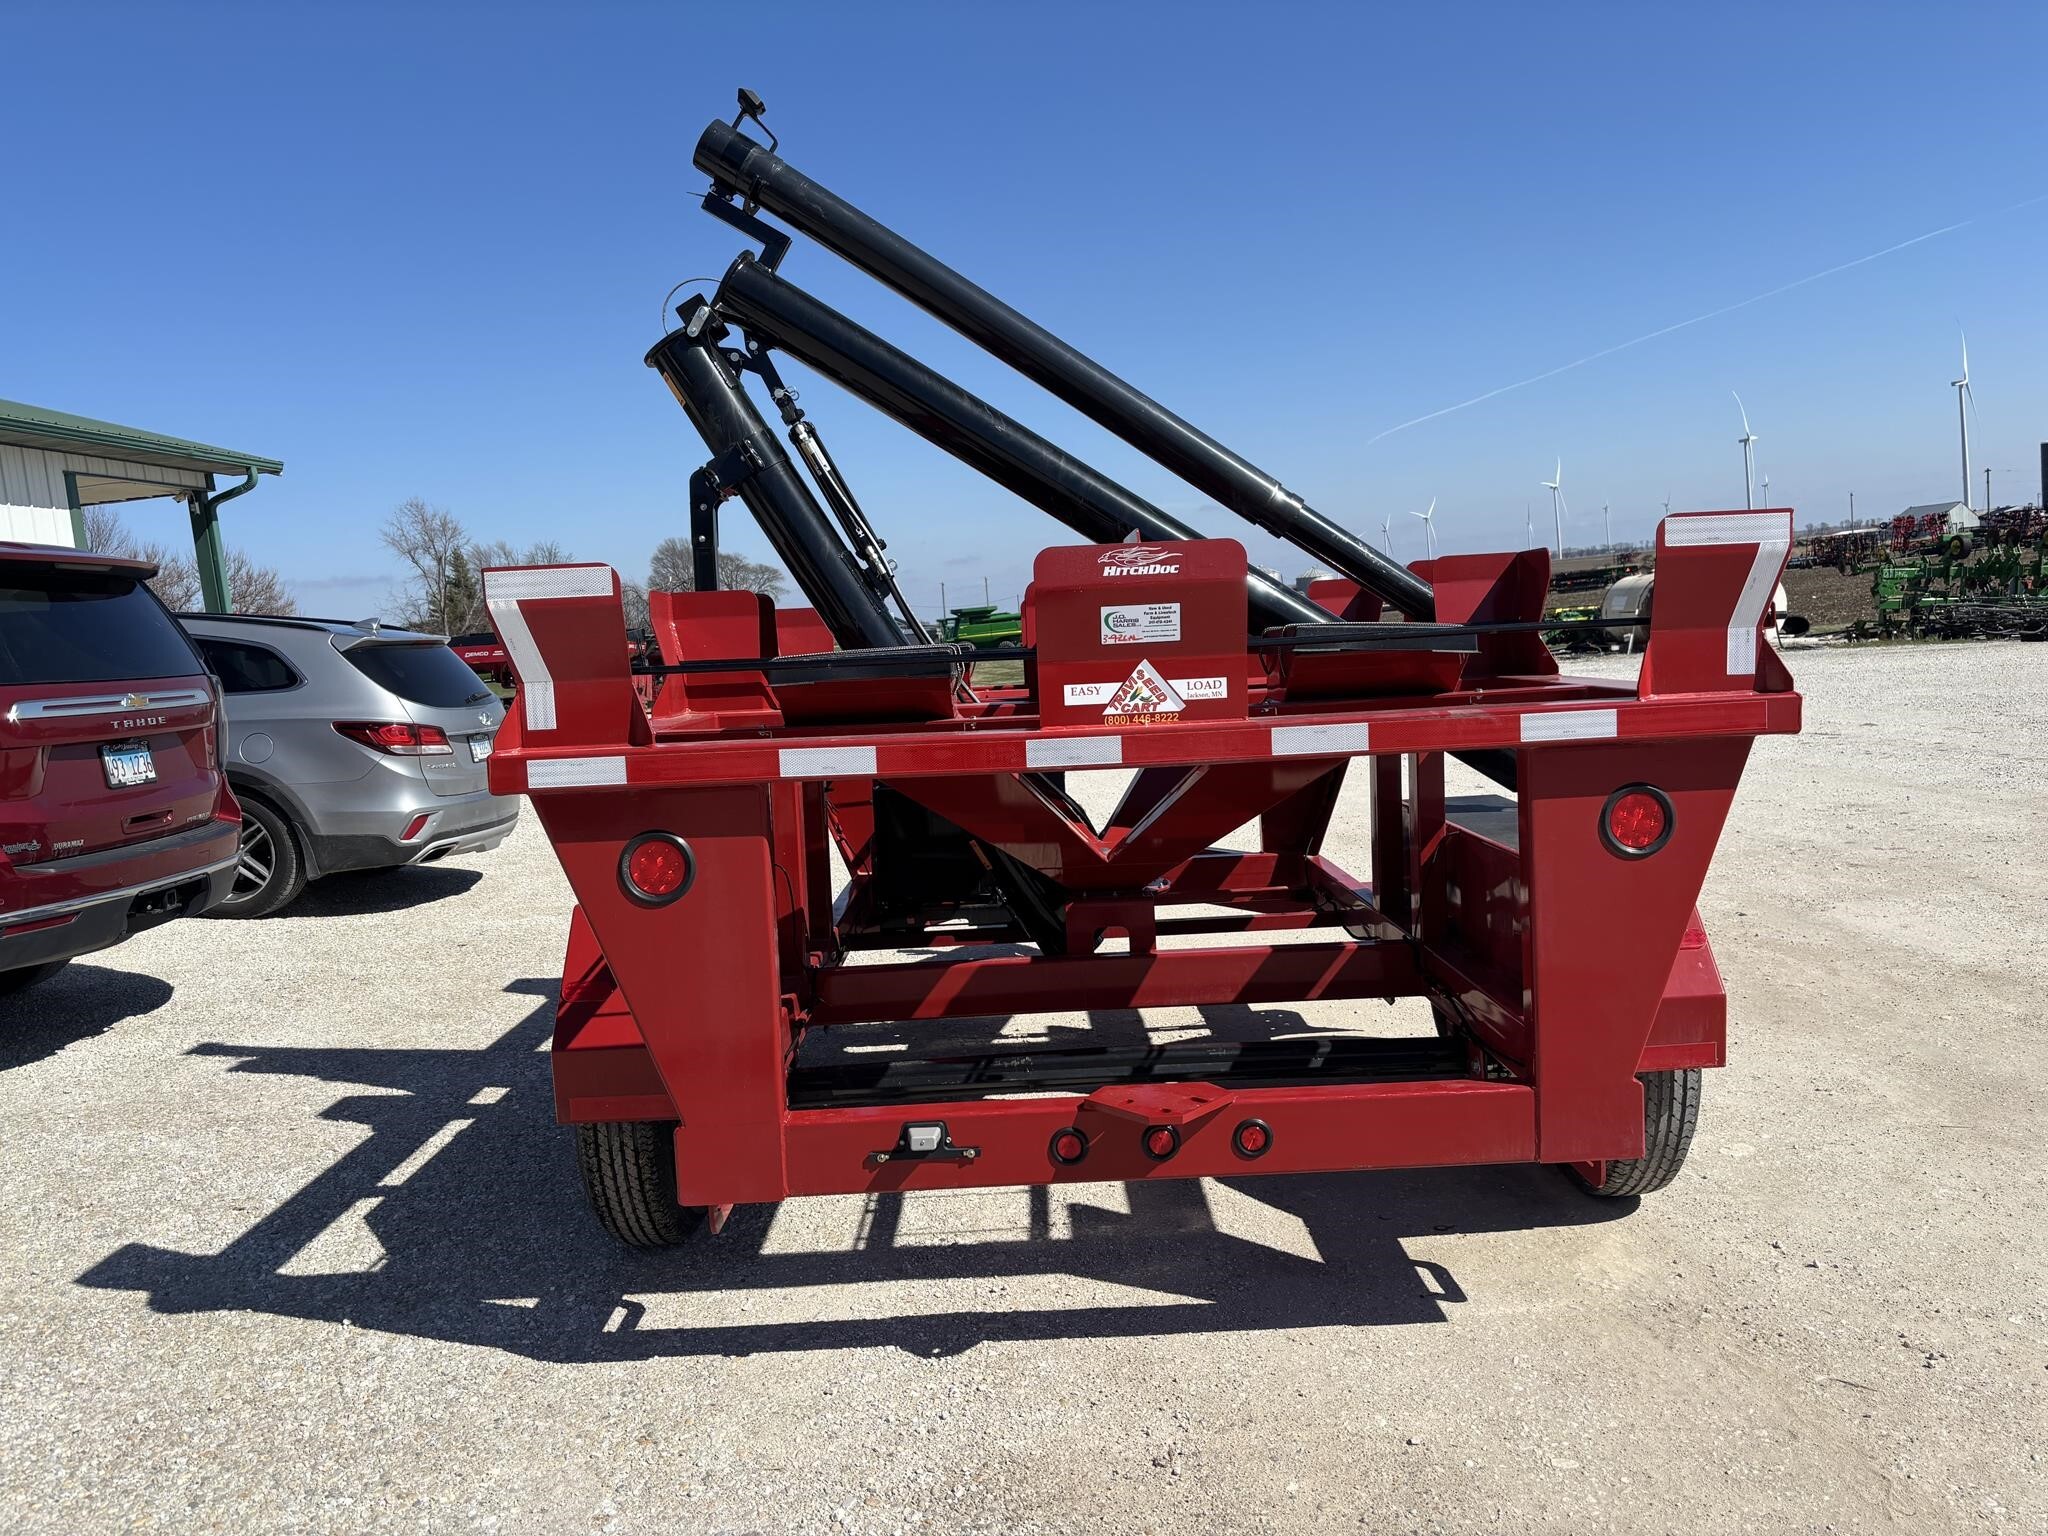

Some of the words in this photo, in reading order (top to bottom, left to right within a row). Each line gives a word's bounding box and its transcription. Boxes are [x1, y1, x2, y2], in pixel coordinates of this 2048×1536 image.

[1071, 686, 1101, 697] EASY
[1187, 680, 1222, 690] LOAD
[1121, 702, 1160, 713] CART
[110, 716, 167, 729] TAHOE
[1104, 715, 1130, 726] (800)
[53, 839, 85, 850] DURAMAX
